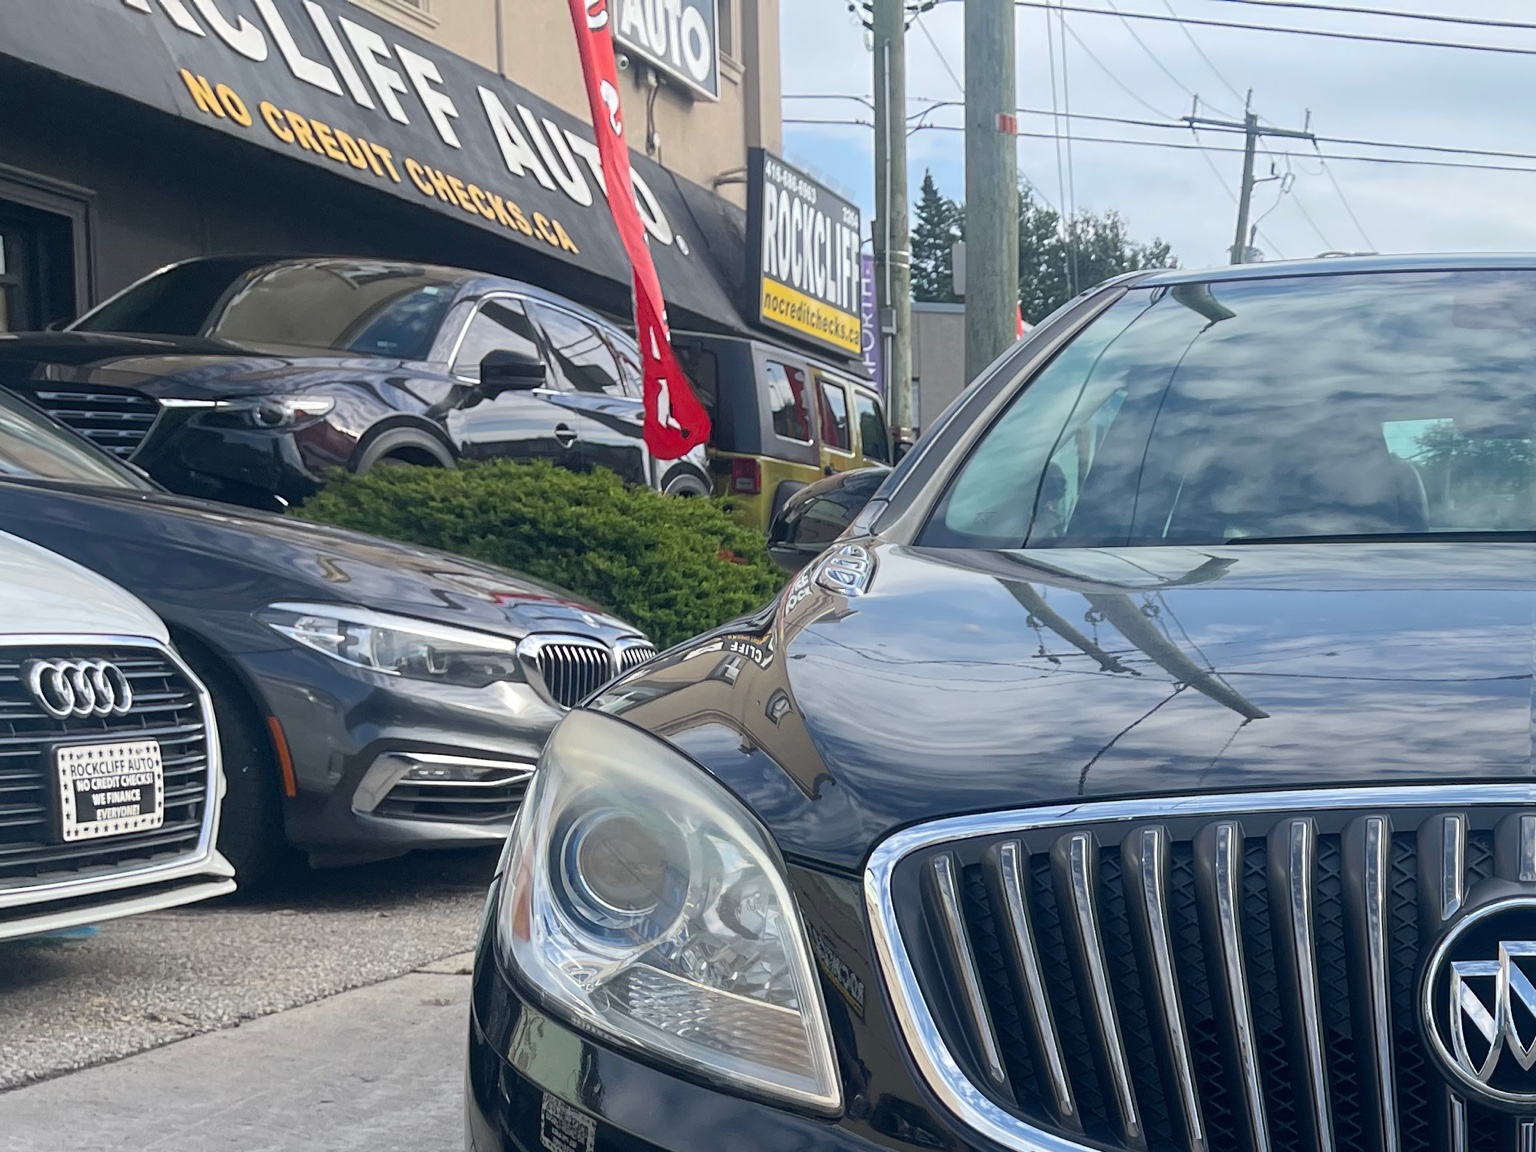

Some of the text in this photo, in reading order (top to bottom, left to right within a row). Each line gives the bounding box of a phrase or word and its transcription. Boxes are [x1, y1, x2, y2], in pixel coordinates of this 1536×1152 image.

[121, 0, 462, 148] CLIFF
[180, 68, 580, 255] NO CREDIT CHECKS.CA
[763, 181, 859, 312] ROCKCLIFF
[764, 291, 860, 345] nocreditchecks.ca
[70, 758, 154, 777] ROCKCLIFF AUTO
[76, 772, 153, 792] NO CREDIT CHECKS!
[92, 789, 141, 806] WE FINANCE
[96, 804, 140, 820] EVERYONE!
